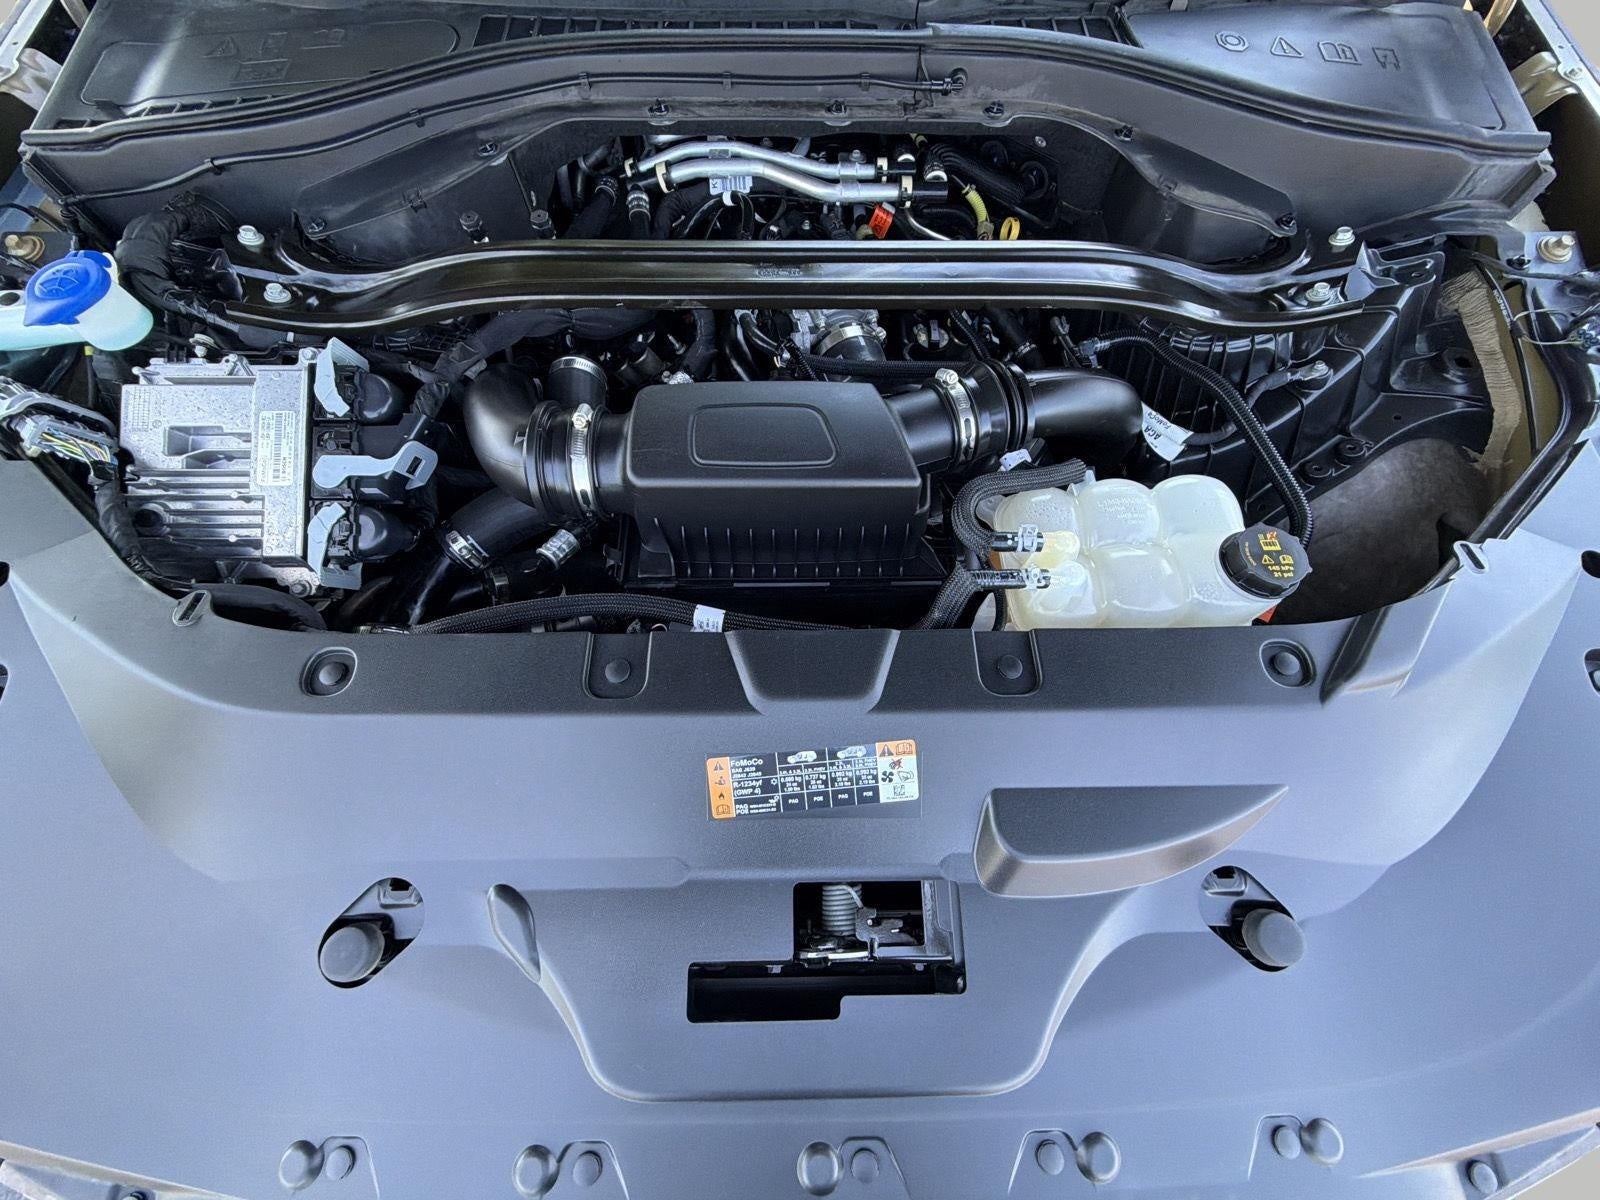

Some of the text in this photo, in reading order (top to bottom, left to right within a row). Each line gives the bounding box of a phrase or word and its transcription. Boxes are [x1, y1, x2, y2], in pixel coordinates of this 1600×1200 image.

[1148, 412, 1171, 430] FoMoCo
[731, 758, 763, 767] FoMoCo
[733, 780, 762, 789] R-1234yf
